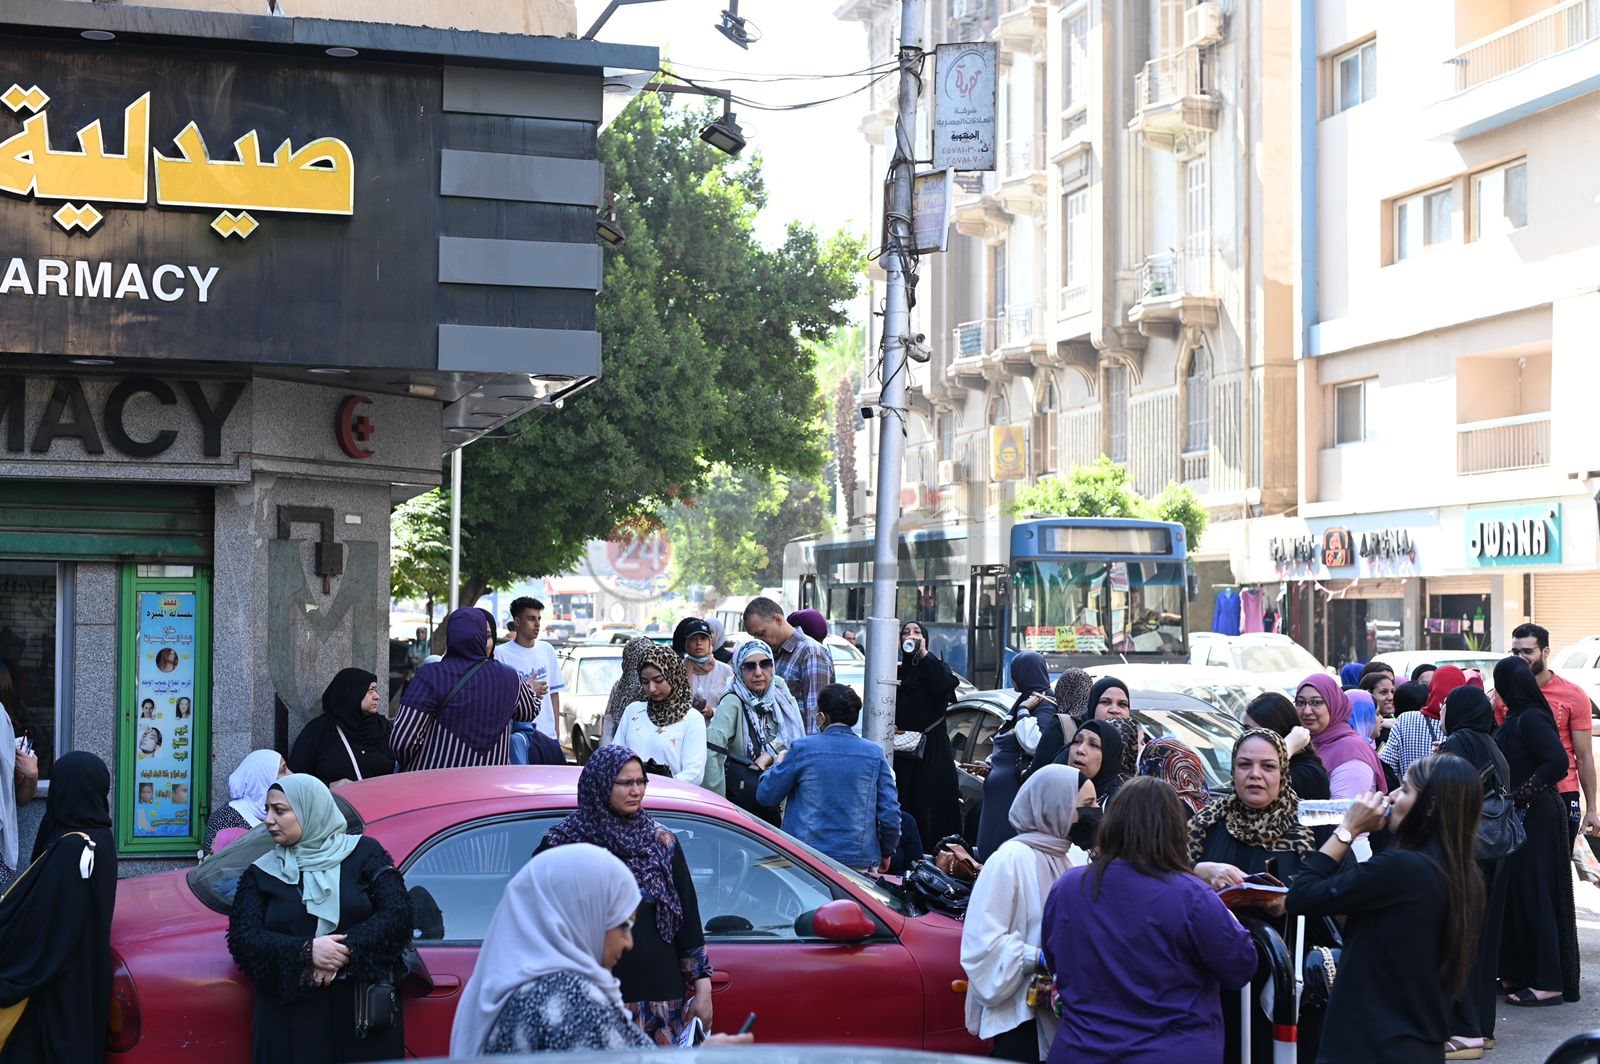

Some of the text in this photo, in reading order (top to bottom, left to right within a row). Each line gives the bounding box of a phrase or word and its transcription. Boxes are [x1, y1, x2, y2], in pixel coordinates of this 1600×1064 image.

[954, 106, 977, 116] شركة
[936, 117, 965, 128] المصرية
[950, 130, 980, 142] الجمهورية
[0, 83, 354, 239] صيدلية
[0, 258, 220, 303] ARMACY
